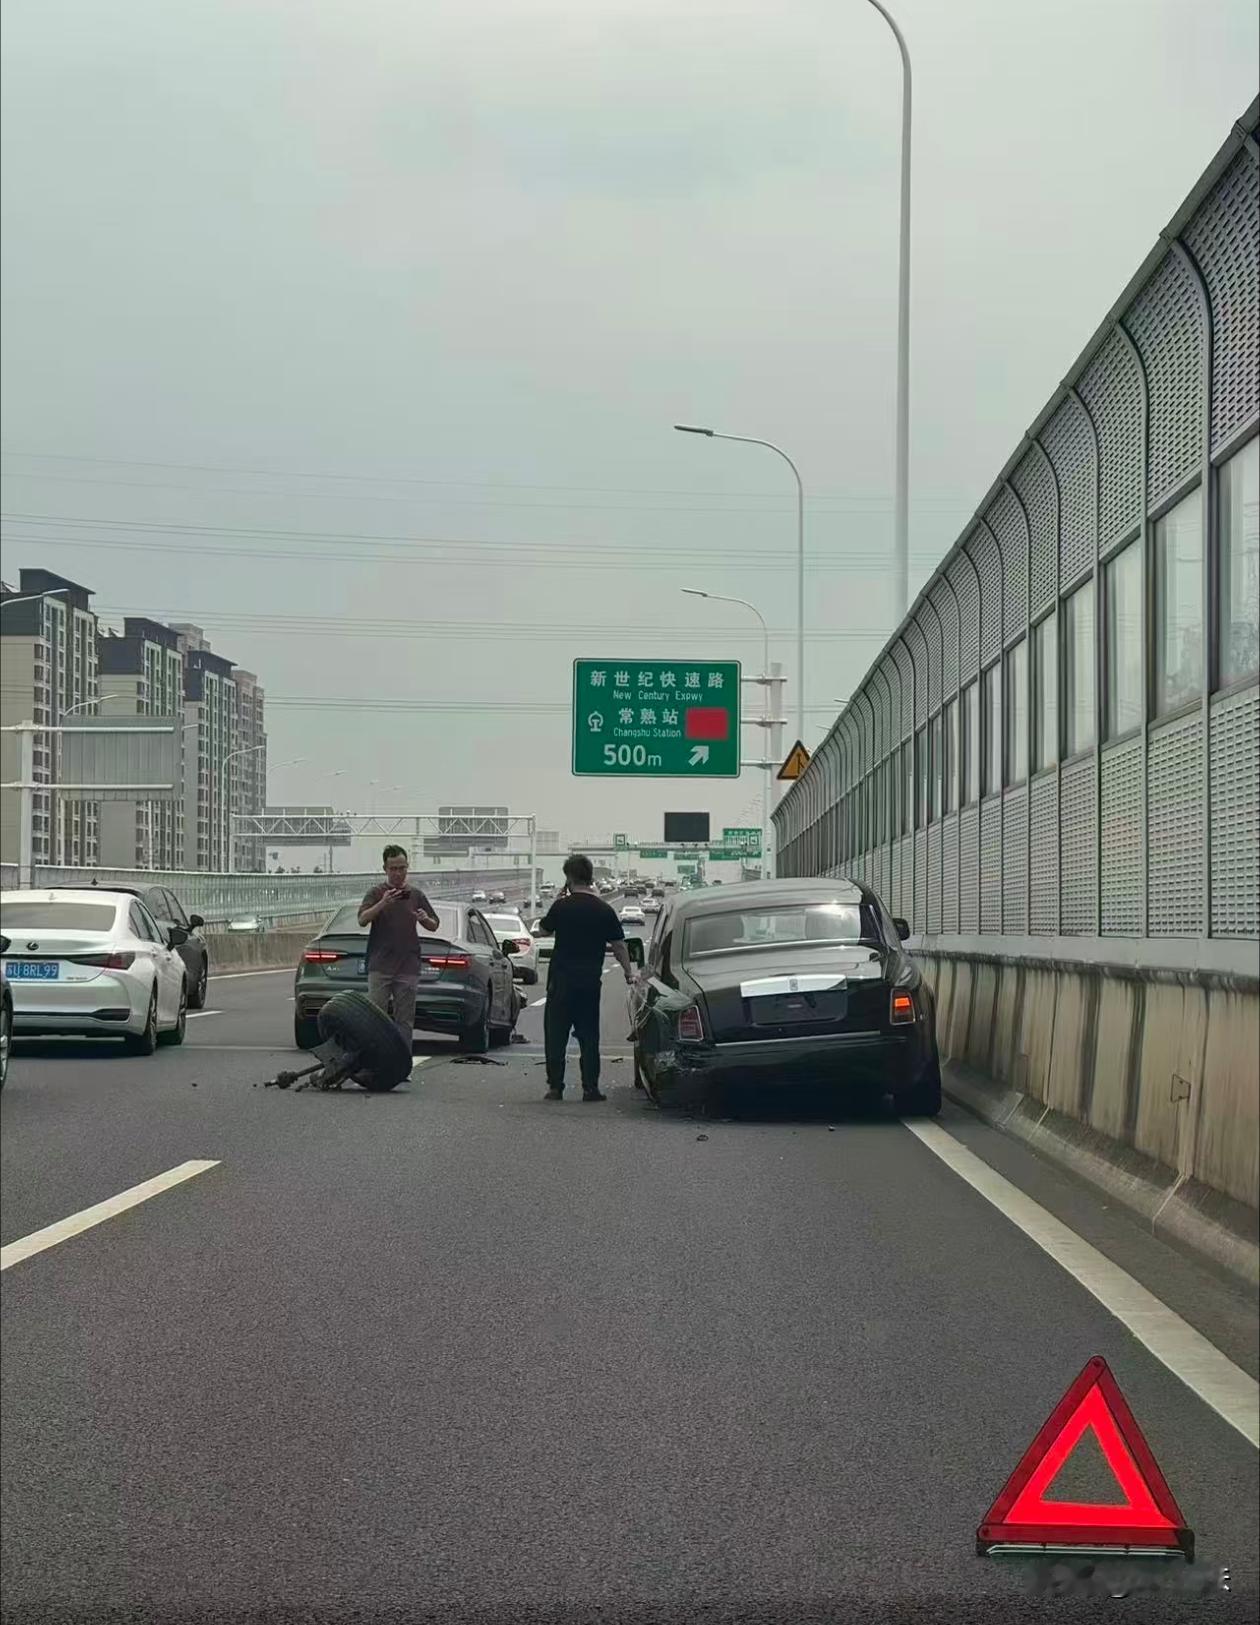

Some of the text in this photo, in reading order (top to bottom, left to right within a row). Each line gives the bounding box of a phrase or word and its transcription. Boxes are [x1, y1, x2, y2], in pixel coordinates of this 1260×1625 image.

[590, 670, 724, 688] 新世纪快速路
[613, 690, 703, 701] New Century Expwy
[618, 708, 679, 725] 常熟站
[613, 727, 681, 738] Changshu Station
